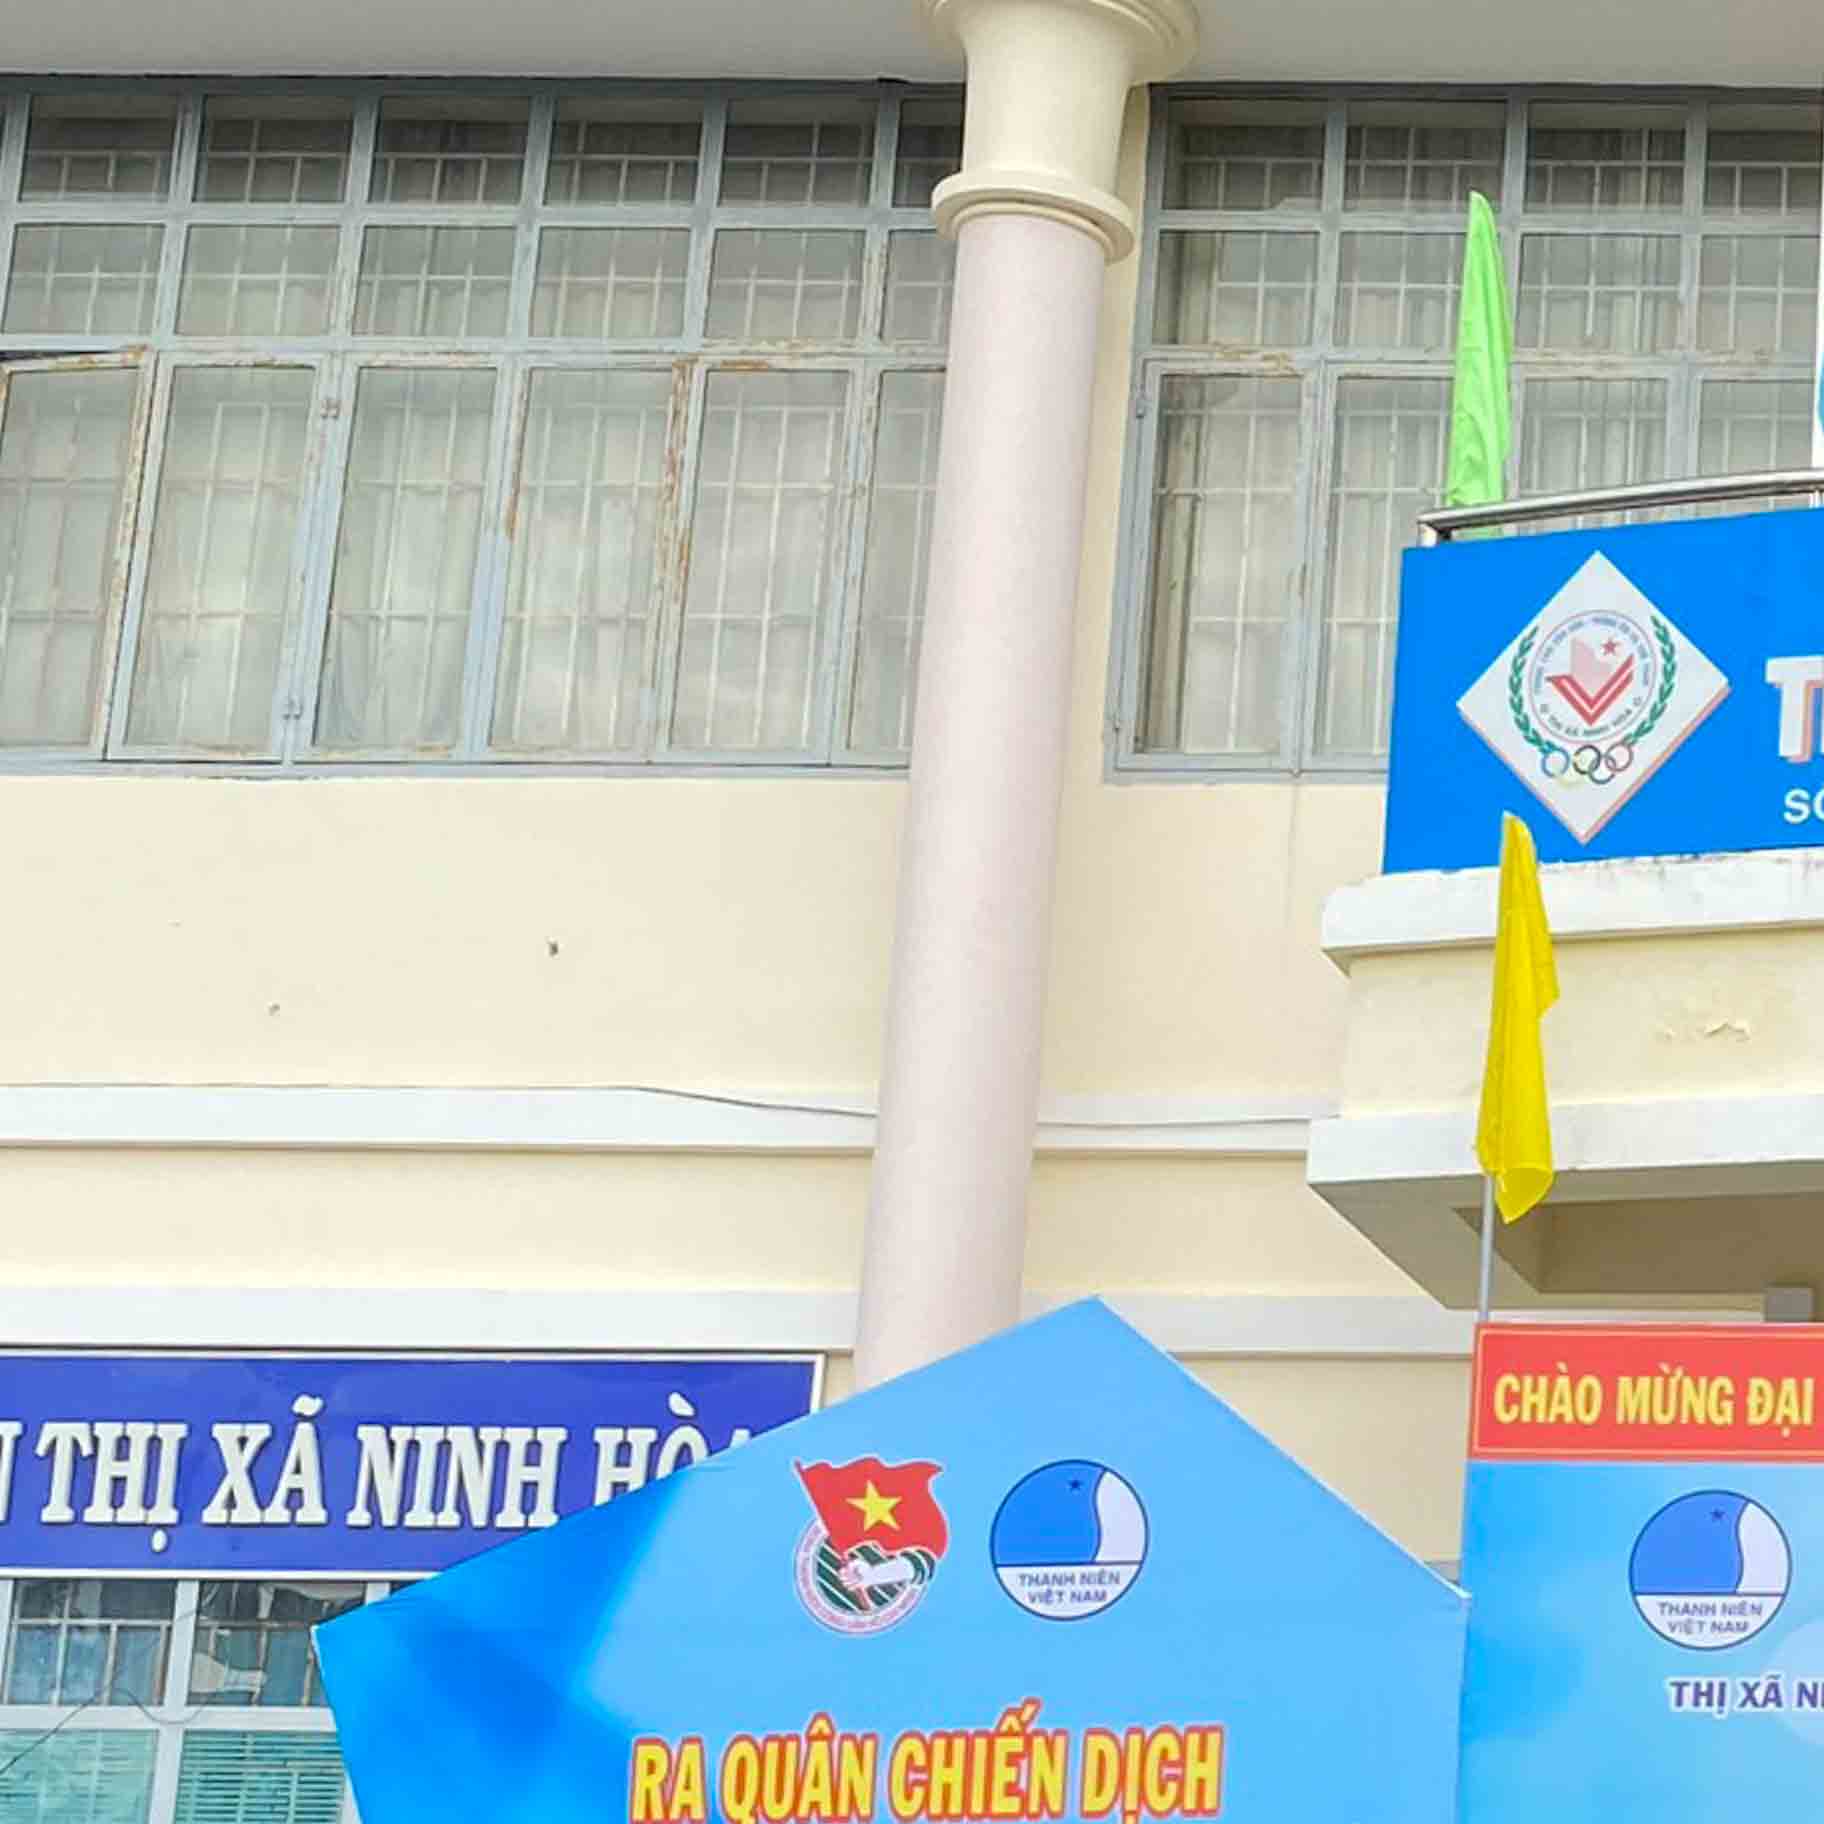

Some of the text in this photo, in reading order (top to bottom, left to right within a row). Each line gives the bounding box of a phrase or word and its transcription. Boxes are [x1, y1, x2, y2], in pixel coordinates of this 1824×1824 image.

[1493, 1362, 1603, 1426] CHÀO
[1616, 1362, 1735, 1427] MỪNG
[1746, 1376, 1814, 1437] ĐẠI
[35, 1421, 188, 1553] THỊ
[202, 1394, 328, 1524] XÃ
[346, 1426, 570, 1528] NINH
[593, 1391, 752, 1507] HÒ
[1019, 1570, 1120, 1589] THANH NIÊN
[1070, 1589, 1107, 1603] NAM
[1658, 1600, 1763, 1618] THANH NIÊN
[1710, 1620, 1749, 1634] NAM
[1670, 1681, 1727, 1715] THỊ
[1738, 1674, 1783, 1709] XÃ
[888, 1698, 1068, 1823] CHIẾN
